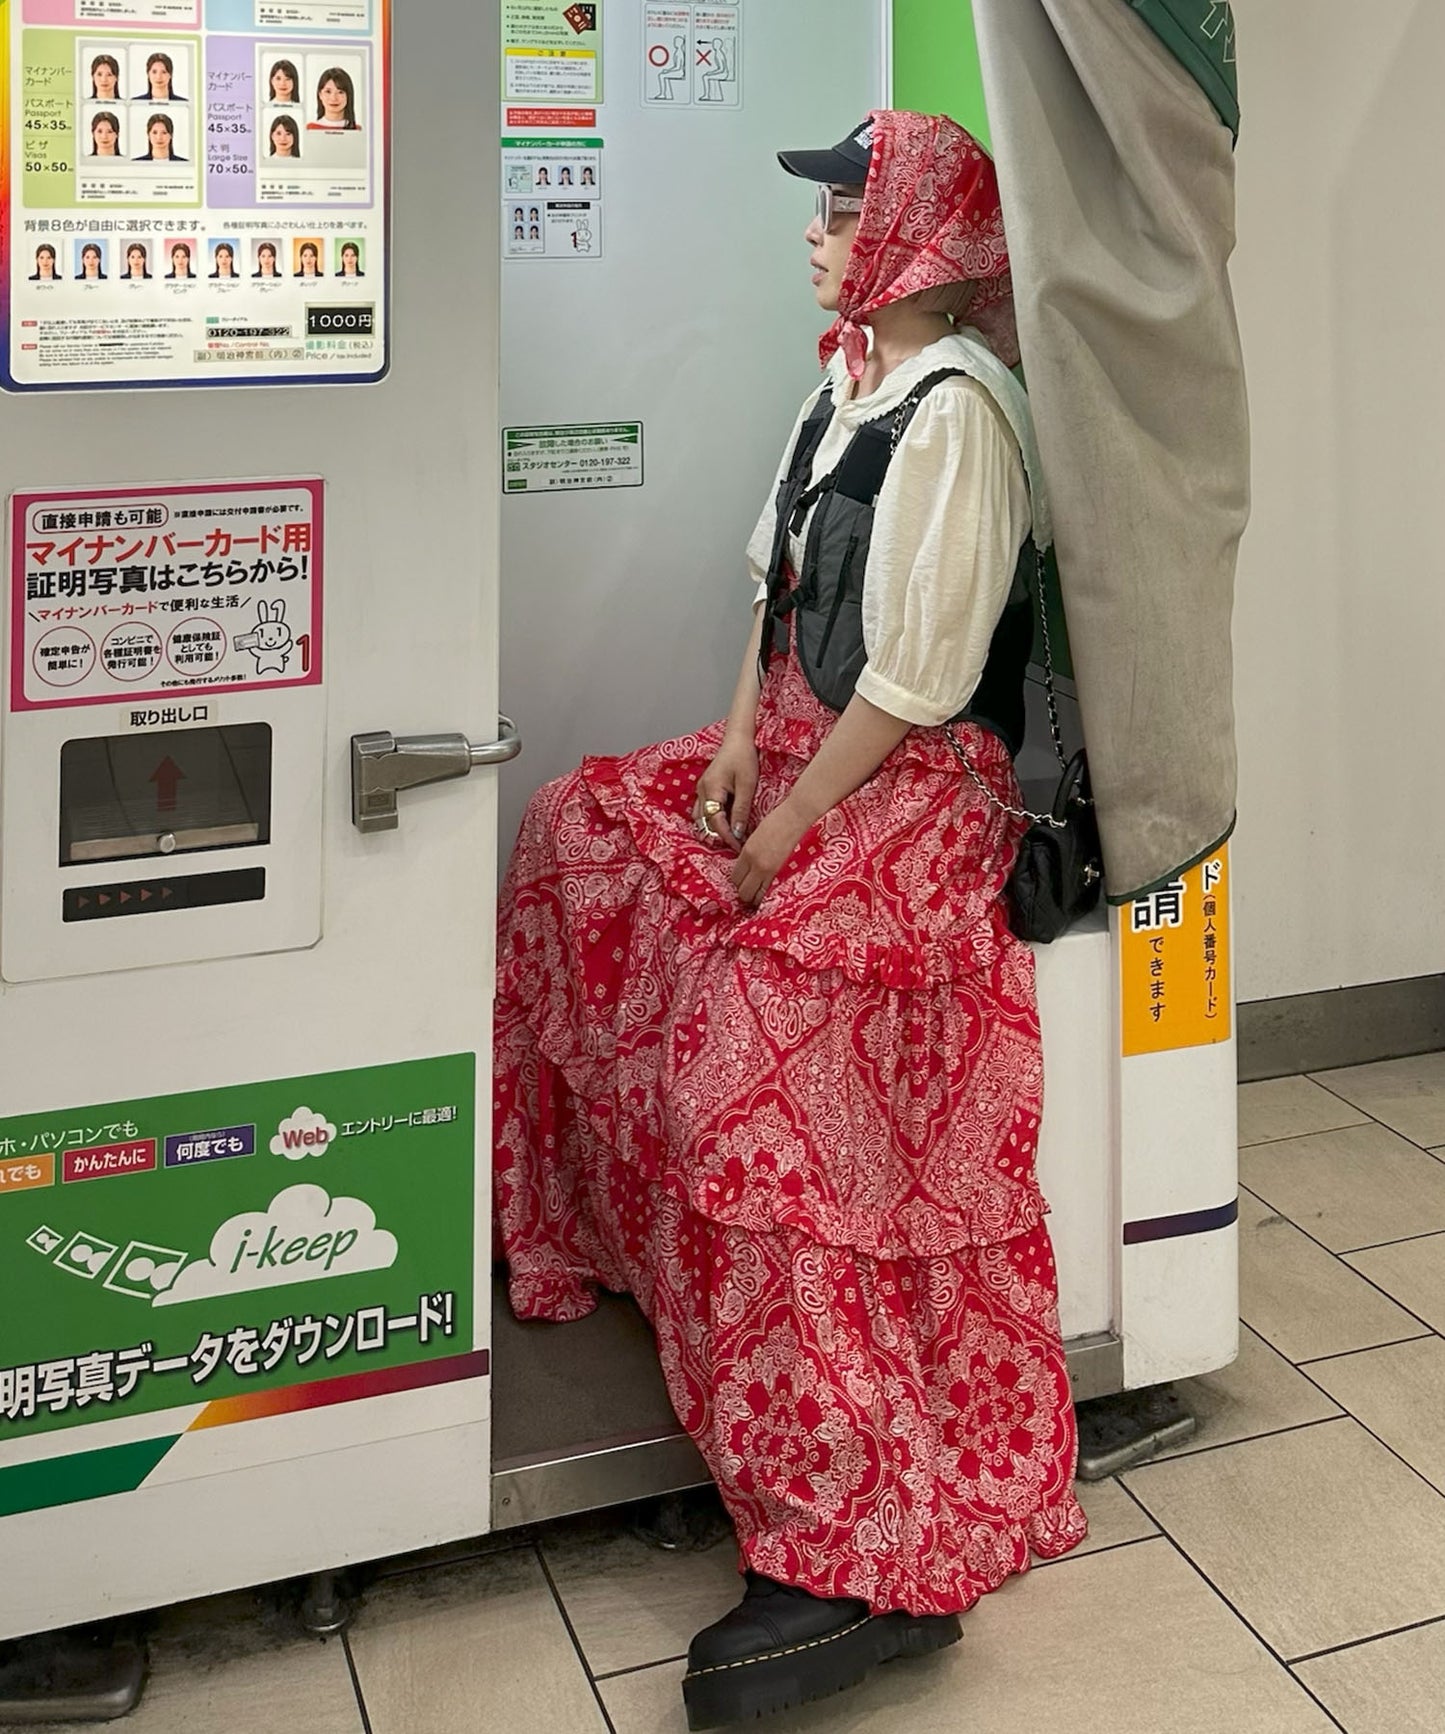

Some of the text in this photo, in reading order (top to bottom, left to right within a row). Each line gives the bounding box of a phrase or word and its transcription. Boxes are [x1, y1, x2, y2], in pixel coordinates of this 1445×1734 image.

[25, 77, 52, 87] カード
[208, 82, 233, 91] カード
[25, 99, 73, 109] パスポート
[208, 103, 254, 113] パスポート
[25, 109, 61, 118] Passport
[208, 113, 242, 121] Passport
[208, 154, 230, 163] Large
[309, 314, 372, 328] 1000円
[579, 456, 631, 468] 0120-197-322
[42, 507, 162, 530] 直接申請も可能
[26, 523, 311, 566] マイナンバーカード用
[39, 595, 240, 621] マイナンバーカードで便利な生活
[110, 634, 154, 647] コンビニで
[180, 641, 214, 654] としても
[40, 643, 91, 658] 確定申告が
[103, 645, 162, 659] 各種証明書を
[130, 706, 209, 726] 取り出し口
[282, 1127, 330, 1149] Web
[176, 1137, 244, 1162] 何度でも
[73, 1148, 147, 1174] かんたんに
[230, 1225, 359, 1274] i-keep
